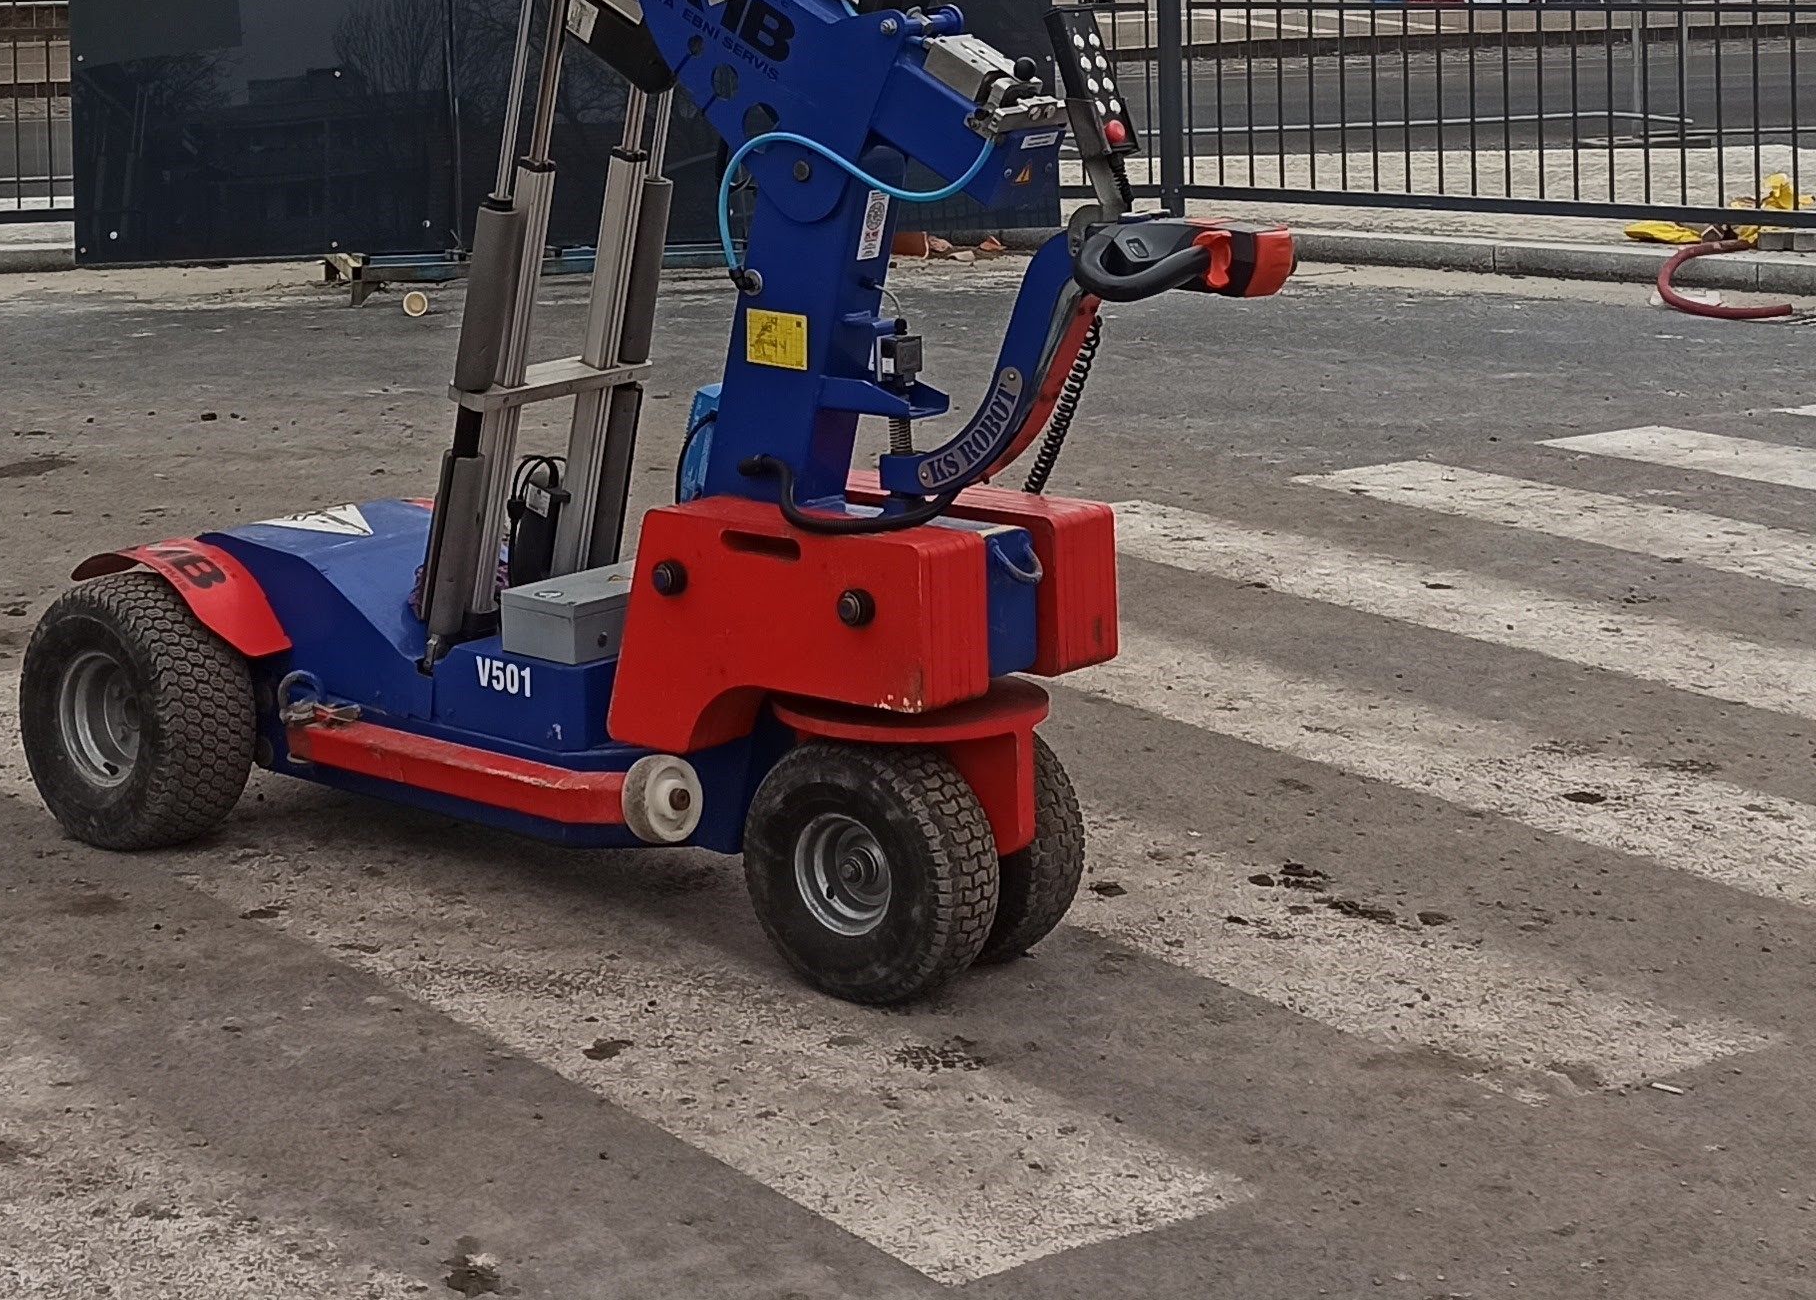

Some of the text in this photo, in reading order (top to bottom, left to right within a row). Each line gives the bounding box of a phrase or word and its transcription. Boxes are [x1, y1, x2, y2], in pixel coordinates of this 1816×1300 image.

[722, 35, 781, 82] SERVIS
[927, 383, 1017, 484] KS ROBOT
[475, 655, 531, 698] V501
